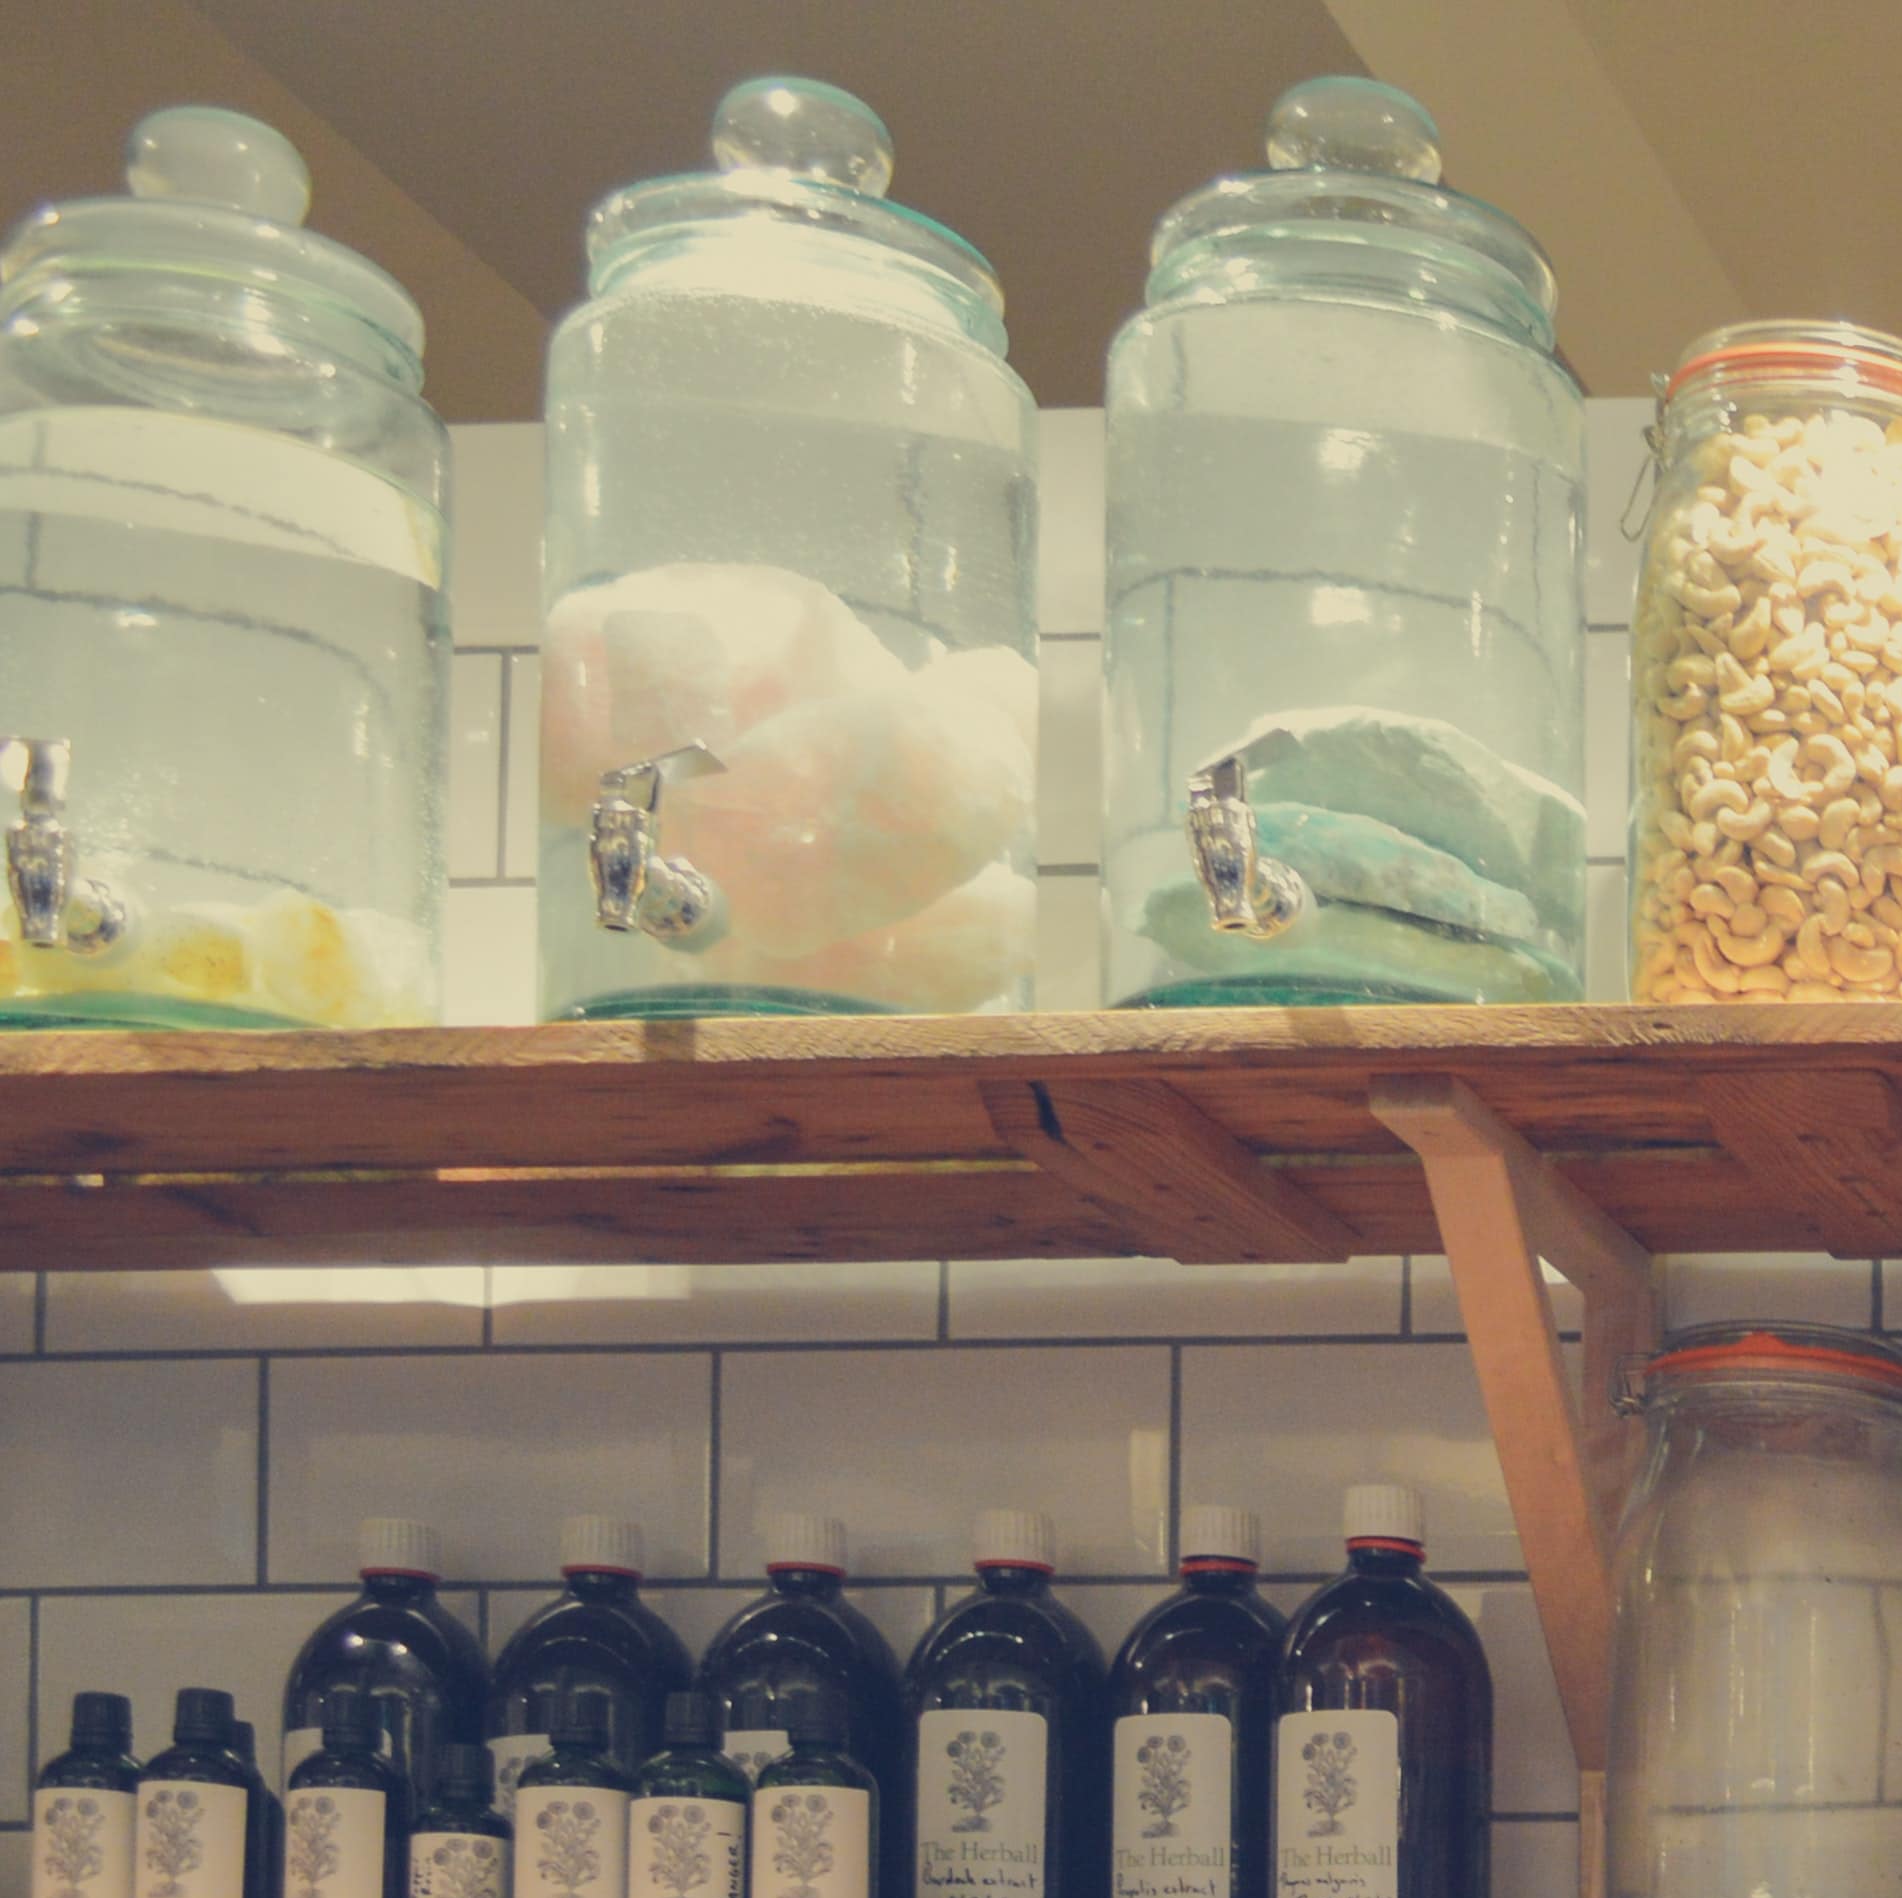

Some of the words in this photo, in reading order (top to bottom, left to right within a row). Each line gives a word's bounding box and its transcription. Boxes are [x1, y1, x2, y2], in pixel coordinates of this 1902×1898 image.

[920, 1841, 955, 1863] The
[960, 1841, 1039, 1865] Herball
[1117, 1848, 1145, 1868] The
[1150, 1846, 1225, 1868] Herball
[1280, 1847, 1313, 1868] The
[1317, 1845, 1394, 1868] Herball
